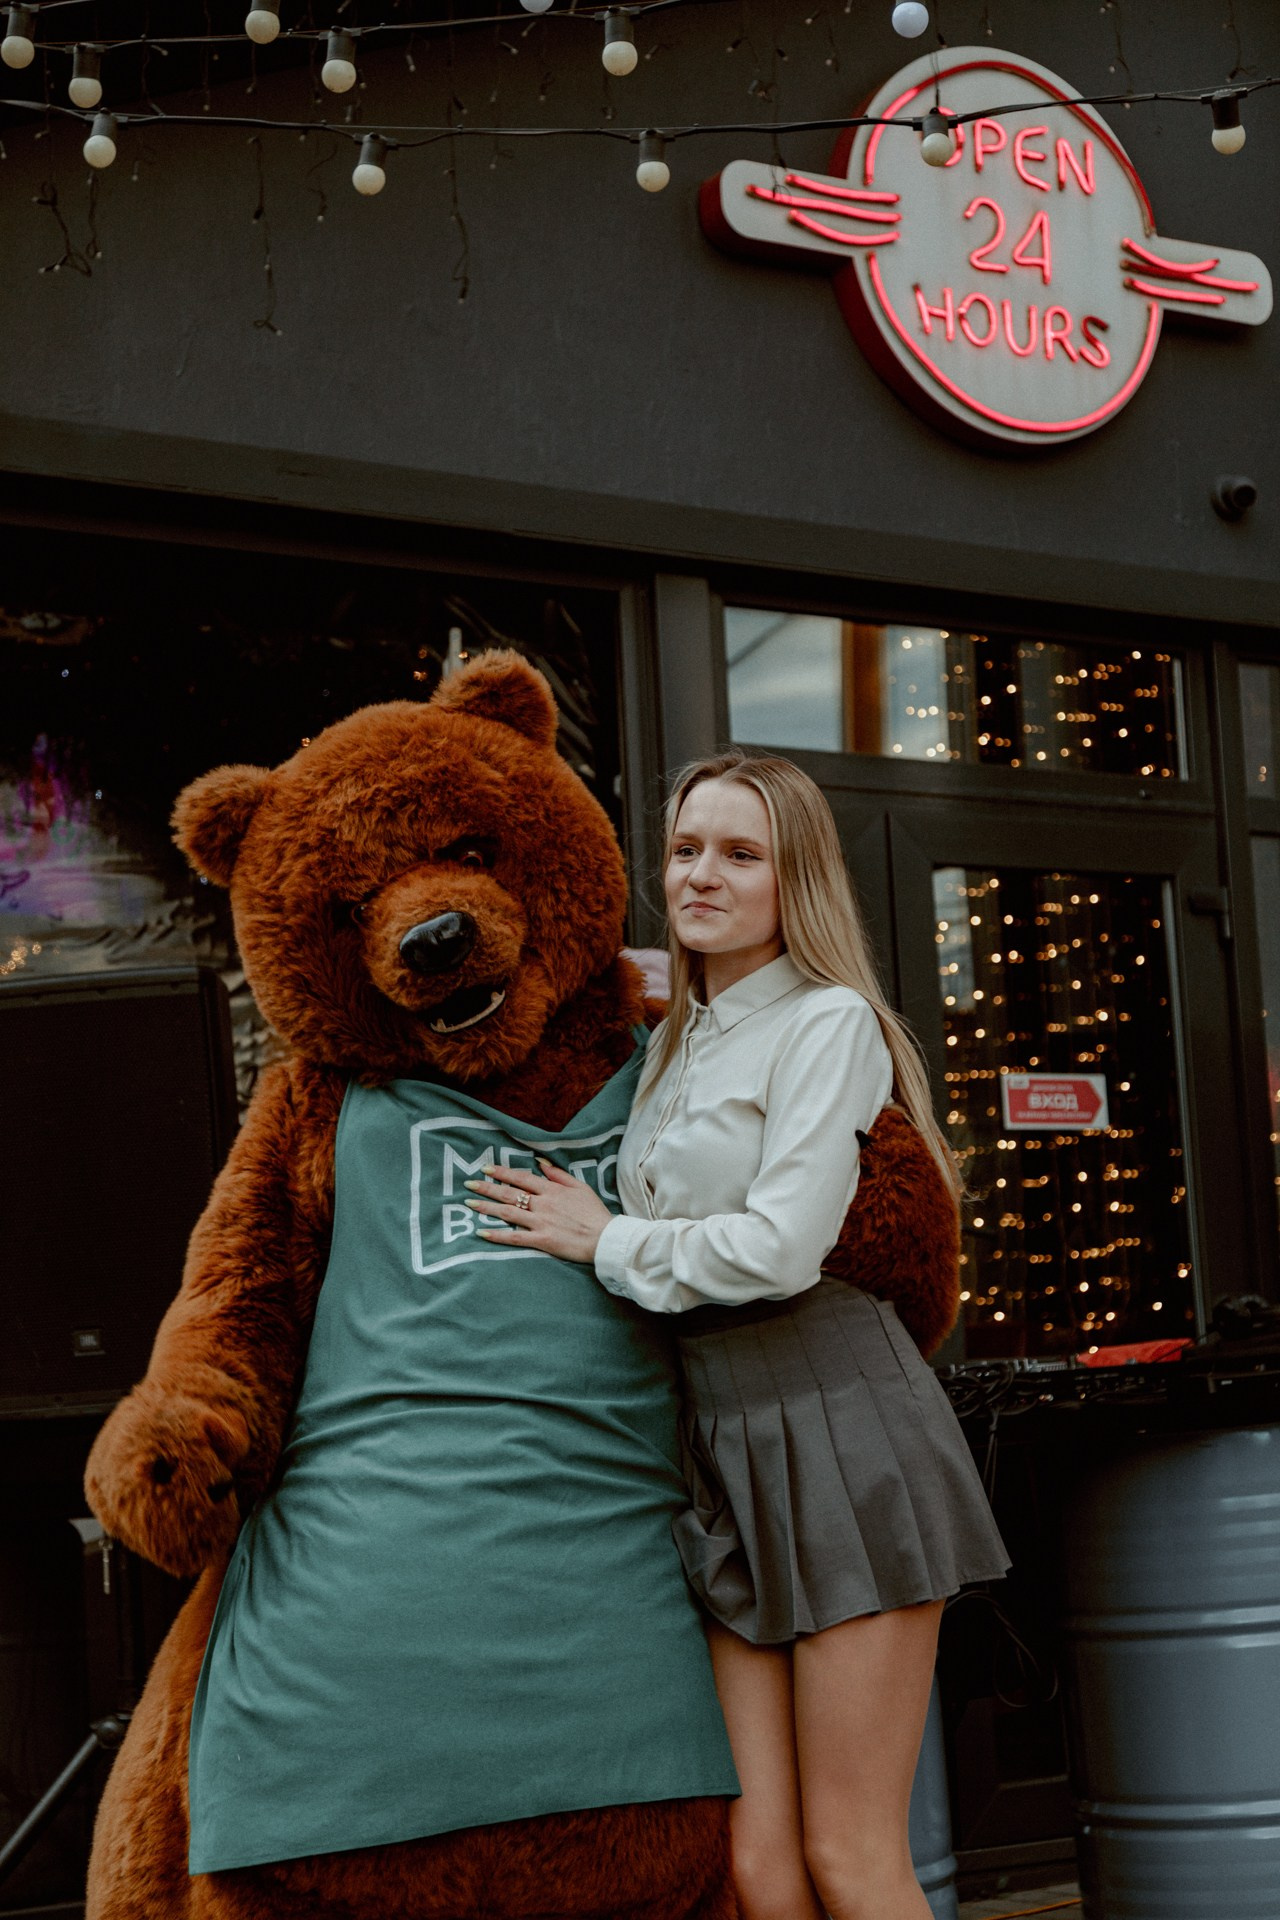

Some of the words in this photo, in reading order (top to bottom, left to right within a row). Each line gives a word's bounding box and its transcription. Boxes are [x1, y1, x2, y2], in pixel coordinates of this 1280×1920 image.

[965, 198, 1052, 284] 24
[913, 283, 1111, 368] HOURS
[1028, 1093, 1079, 1111] ВХОД
